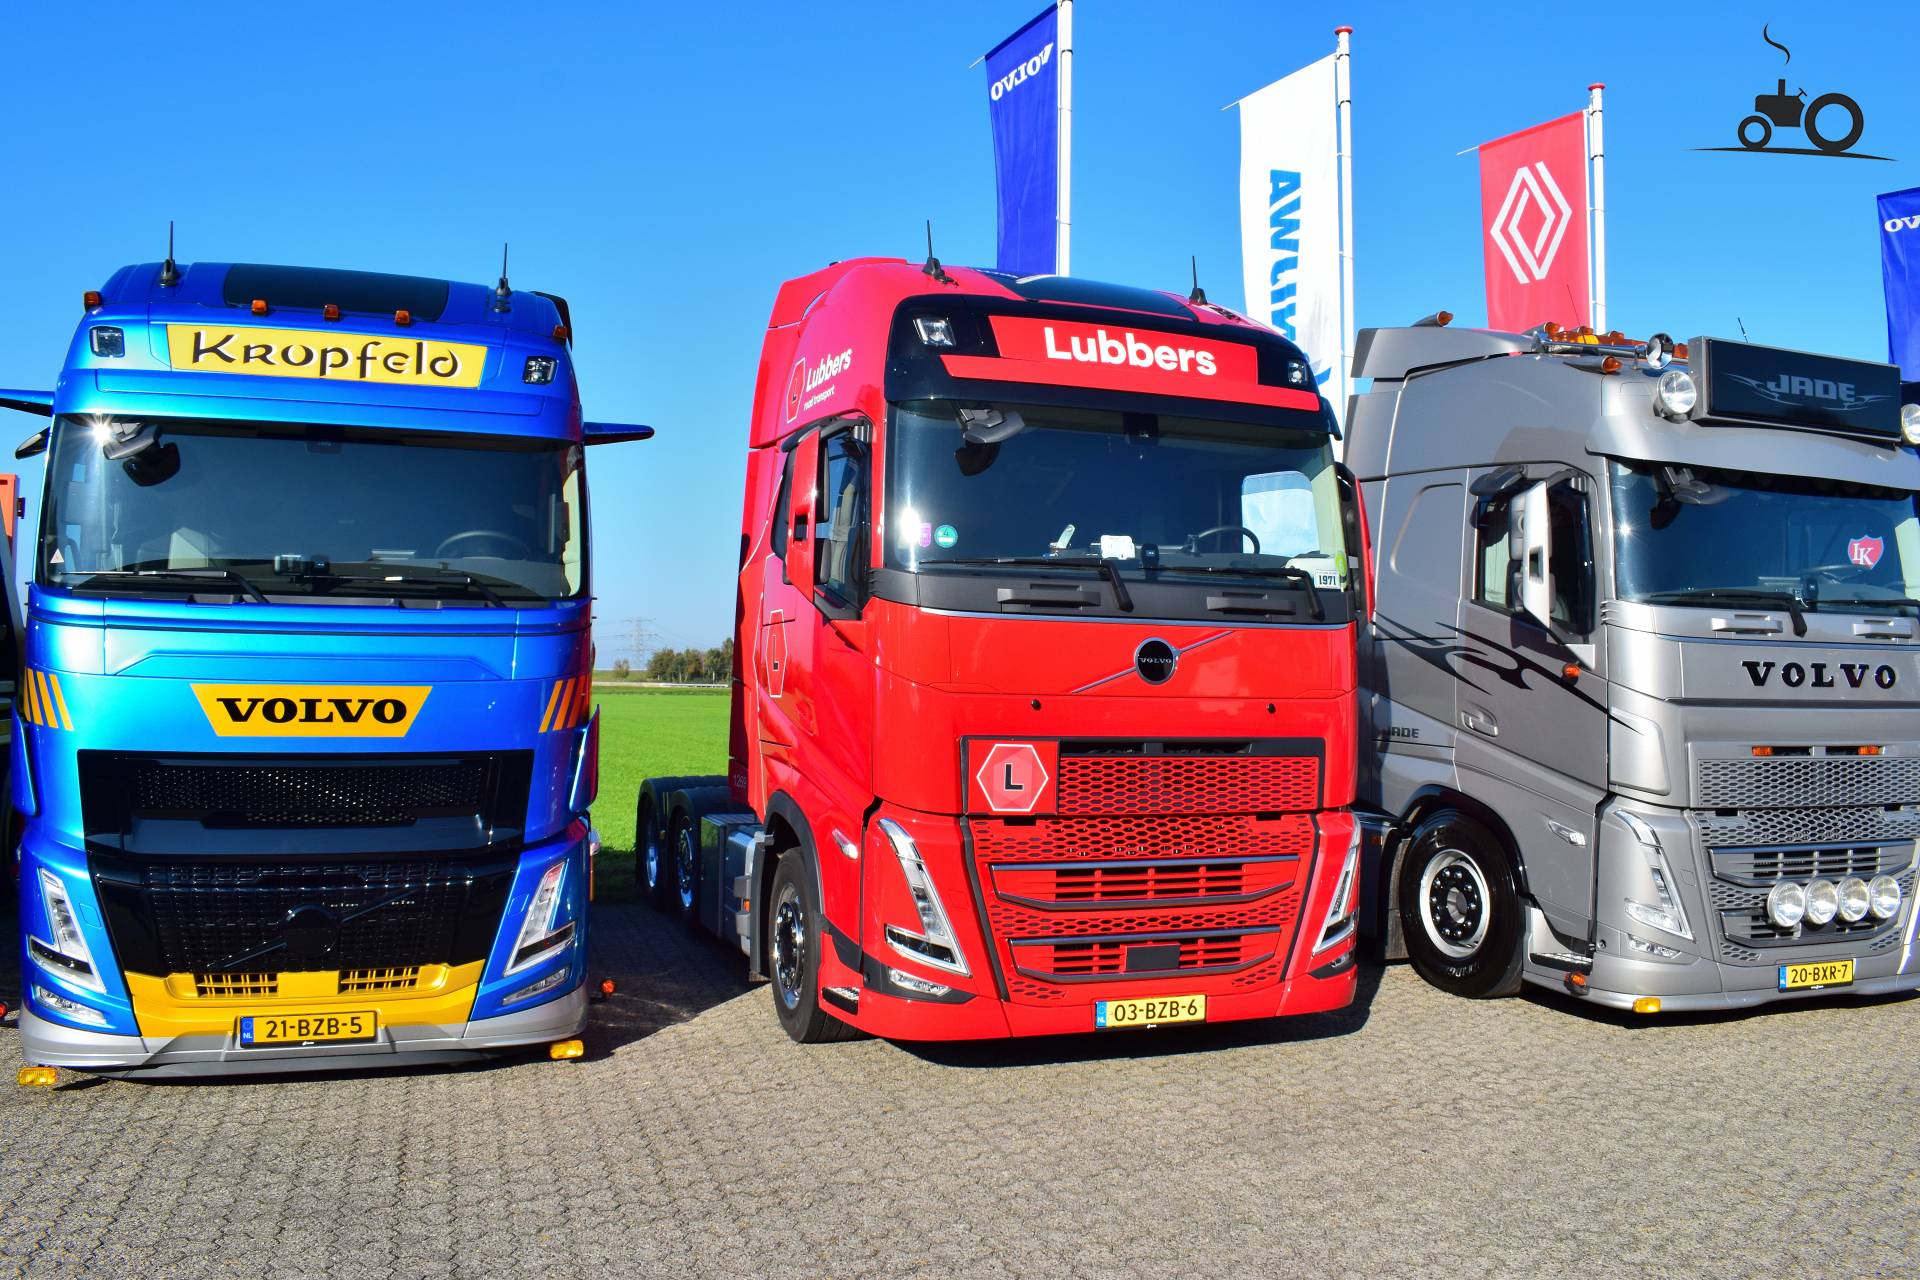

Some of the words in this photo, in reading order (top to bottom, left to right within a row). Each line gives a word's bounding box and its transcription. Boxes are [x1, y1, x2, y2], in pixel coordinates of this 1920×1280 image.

[1044, 326, 1217, 376] Lubbers
[806, 348, 853, 392] Lubbers
[1766, 374, 1855, 402] JADE
[1319, 575, 1337, 586] 1971
[1741, 660, 1896, 689] VOLVO
[216, 698, 407, 724] VOLVO
[1004, 763, 1024, 791] L
[1791, 964, 1848, 984] 20-BXR-7
[1114, 999, 1198, 1022] 03-BZB-6
[265, 1016, 362, 1038] 21-BZB-5
